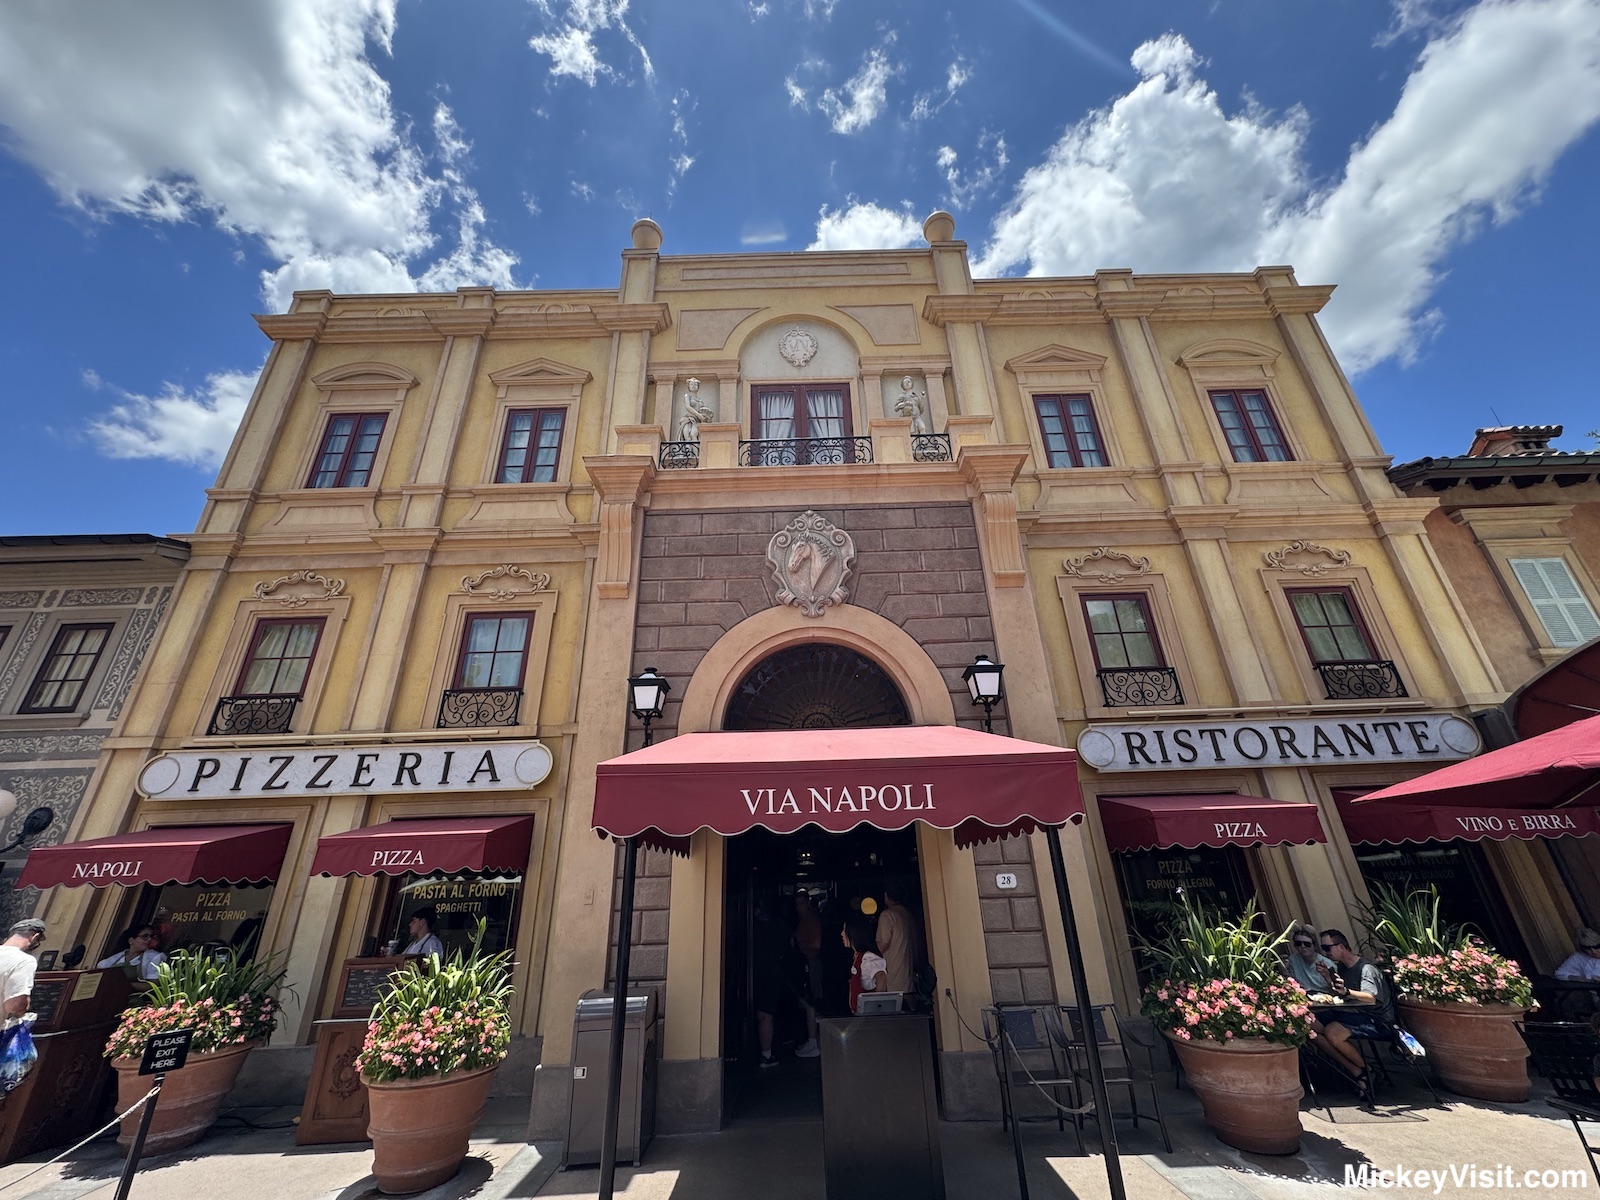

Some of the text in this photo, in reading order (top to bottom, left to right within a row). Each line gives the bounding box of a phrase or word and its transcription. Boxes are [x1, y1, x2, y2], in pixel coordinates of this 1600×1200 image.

[1121, 721, 1439, 765] RISTORANTE
[187, 750, 501, 792] PIZZERIA
[740, 784, 936, 815] VIA NAPOLI
[1213, 822, 1268, 838] PIZZA
[1456, 816, 1503, 831] VINO
[1521, 815, 1577, 830] BIRRA
[371, 850, 424, 866] PIZZA
[72, 861, 143, 878] NAPOLI
[1158, 860, 1193, 874] PIZZA
[1001, 876, 1011, 885] 28
[1146, 879, 1176, 889] FORNO
[413, 882, 506, 899] PASTA AL FORNO
[196, 893, 231, 907] PIZZA
[435, 902, 481, 913] SPAGHETTI
[171, 910, 246, 922] PASTA AL FORNO
[152, 1036, 187, 1047] PLEASE
[155, 1047, 178, 1058] EXIT
[150, 1058, 176, 1069] HERE
